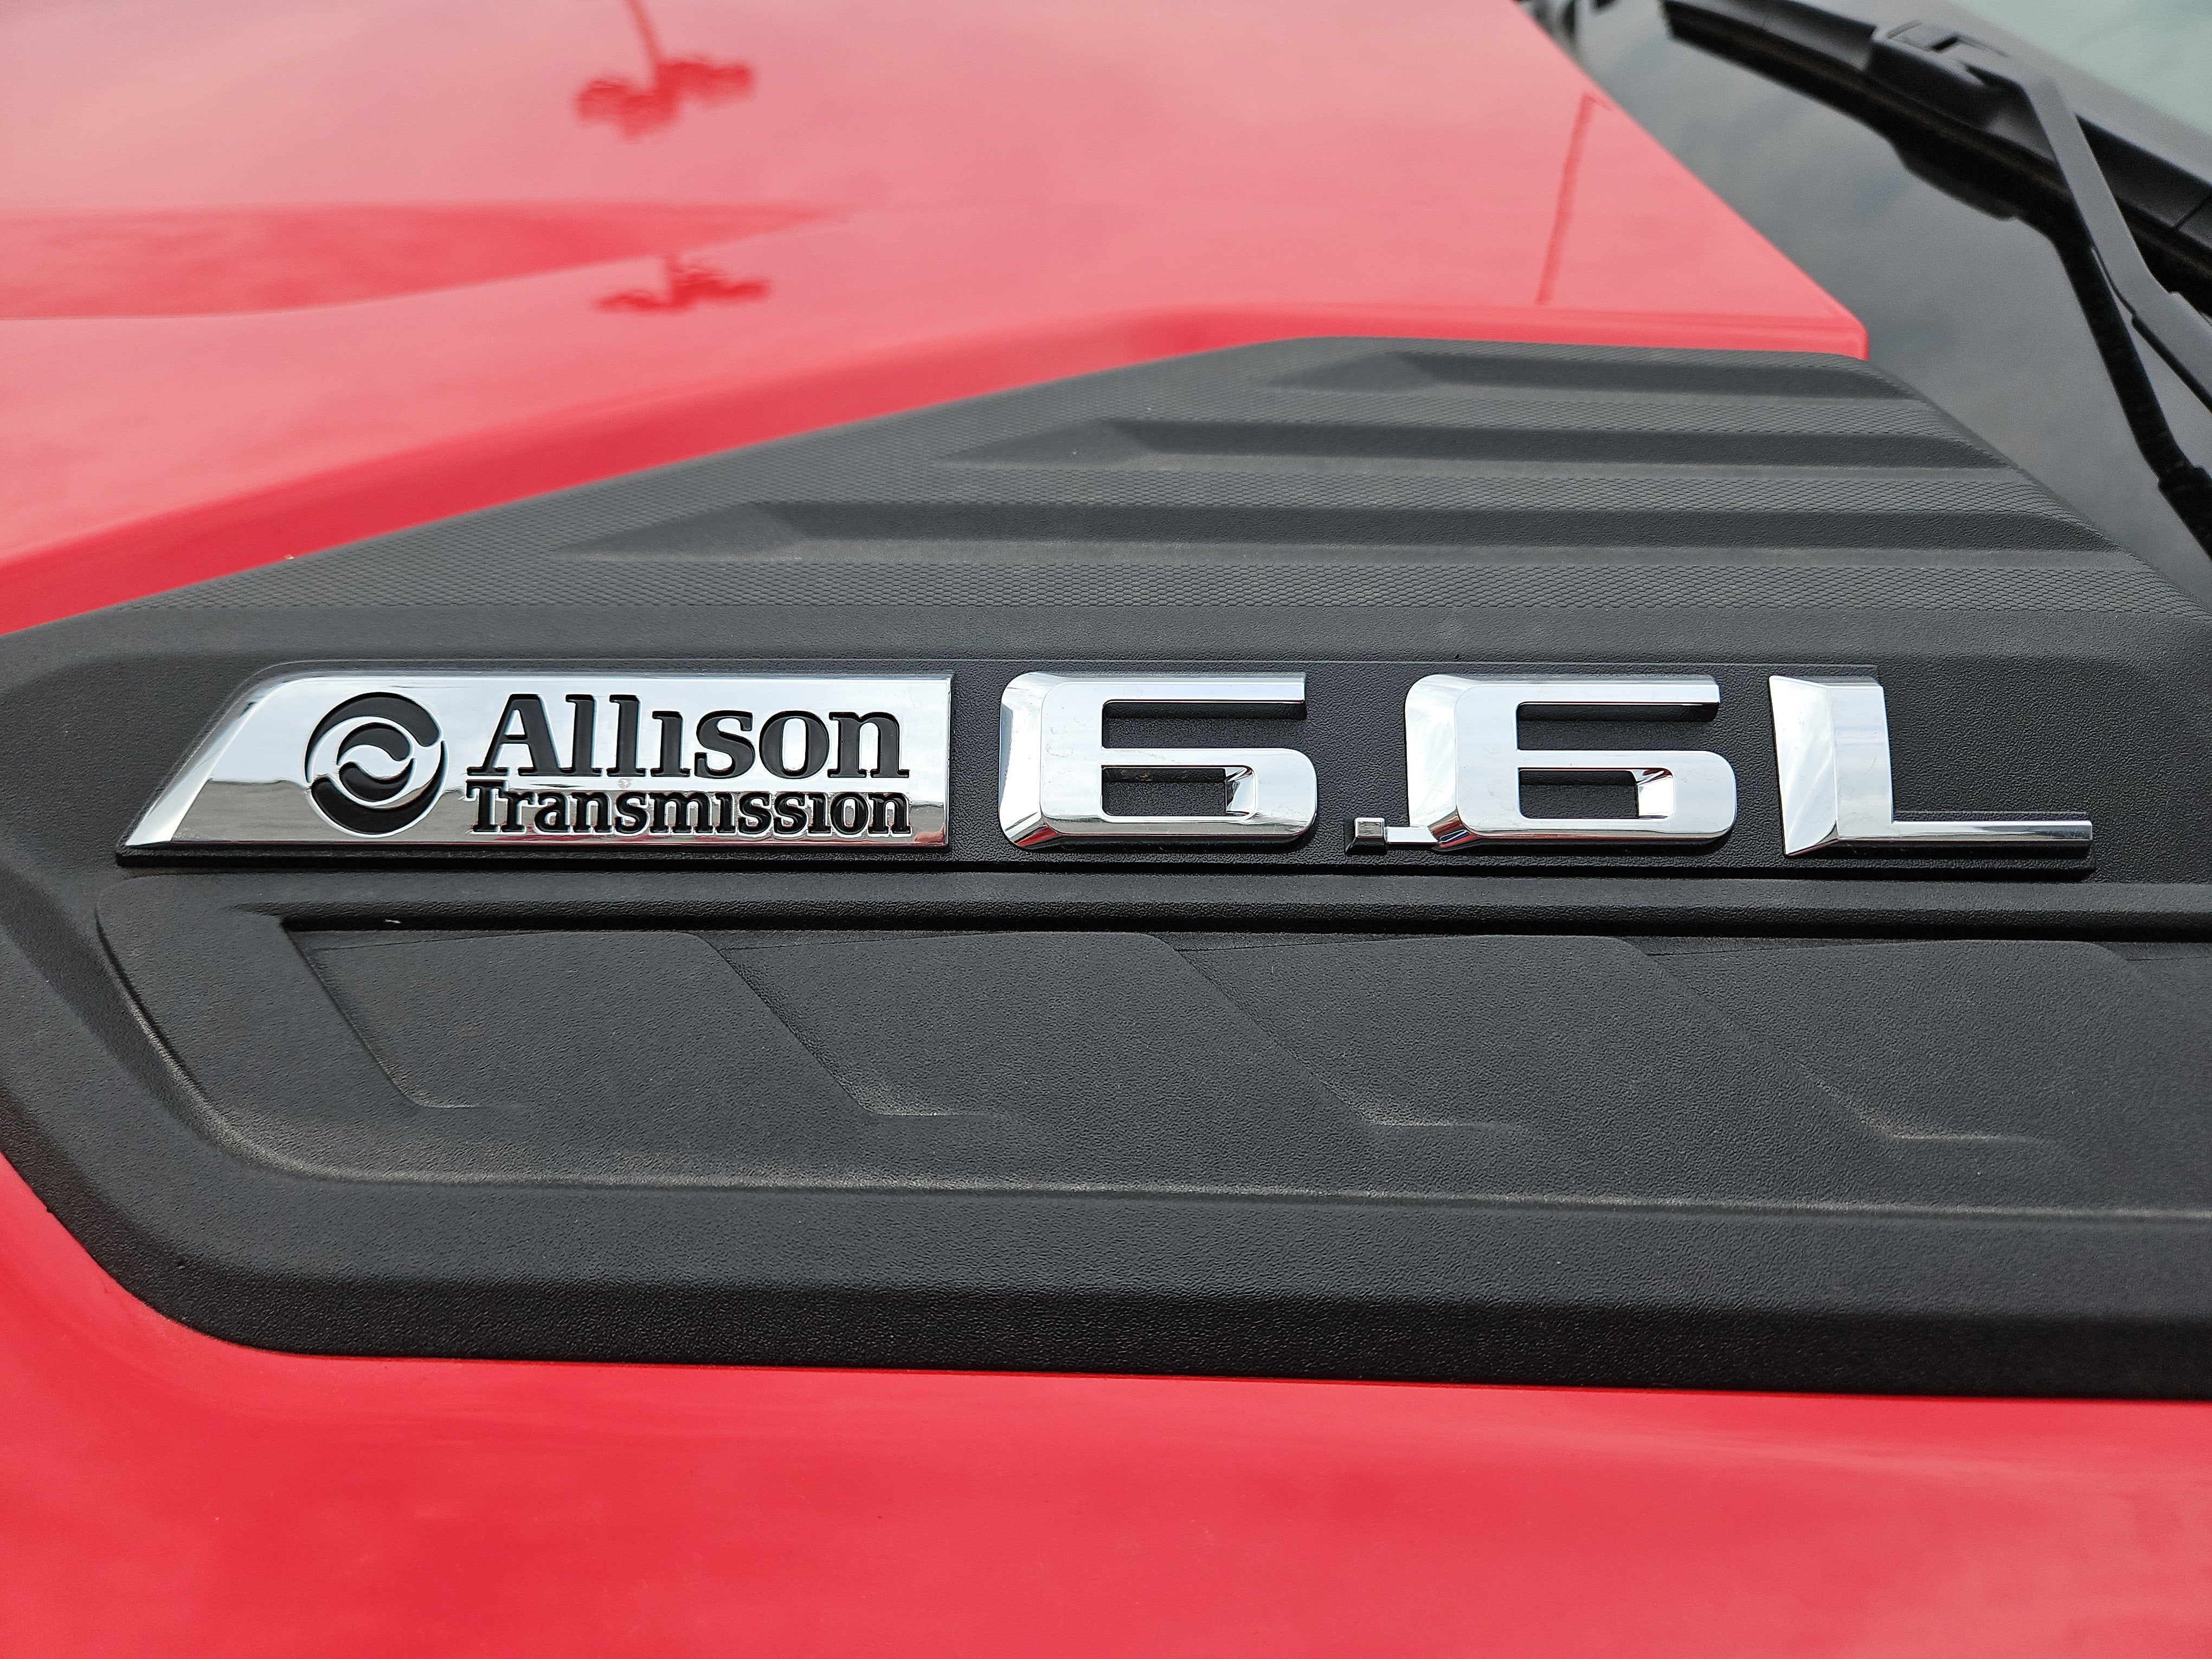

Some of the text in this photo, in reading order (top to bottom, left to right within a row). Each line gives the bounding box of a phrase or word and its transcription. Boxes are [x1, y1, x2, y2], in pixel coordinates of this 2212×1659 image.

[467, 693, 910, 778] Allison
[999, 671, 2094, 858] 6.6L
[467, 780, 912, 835] Transmission
